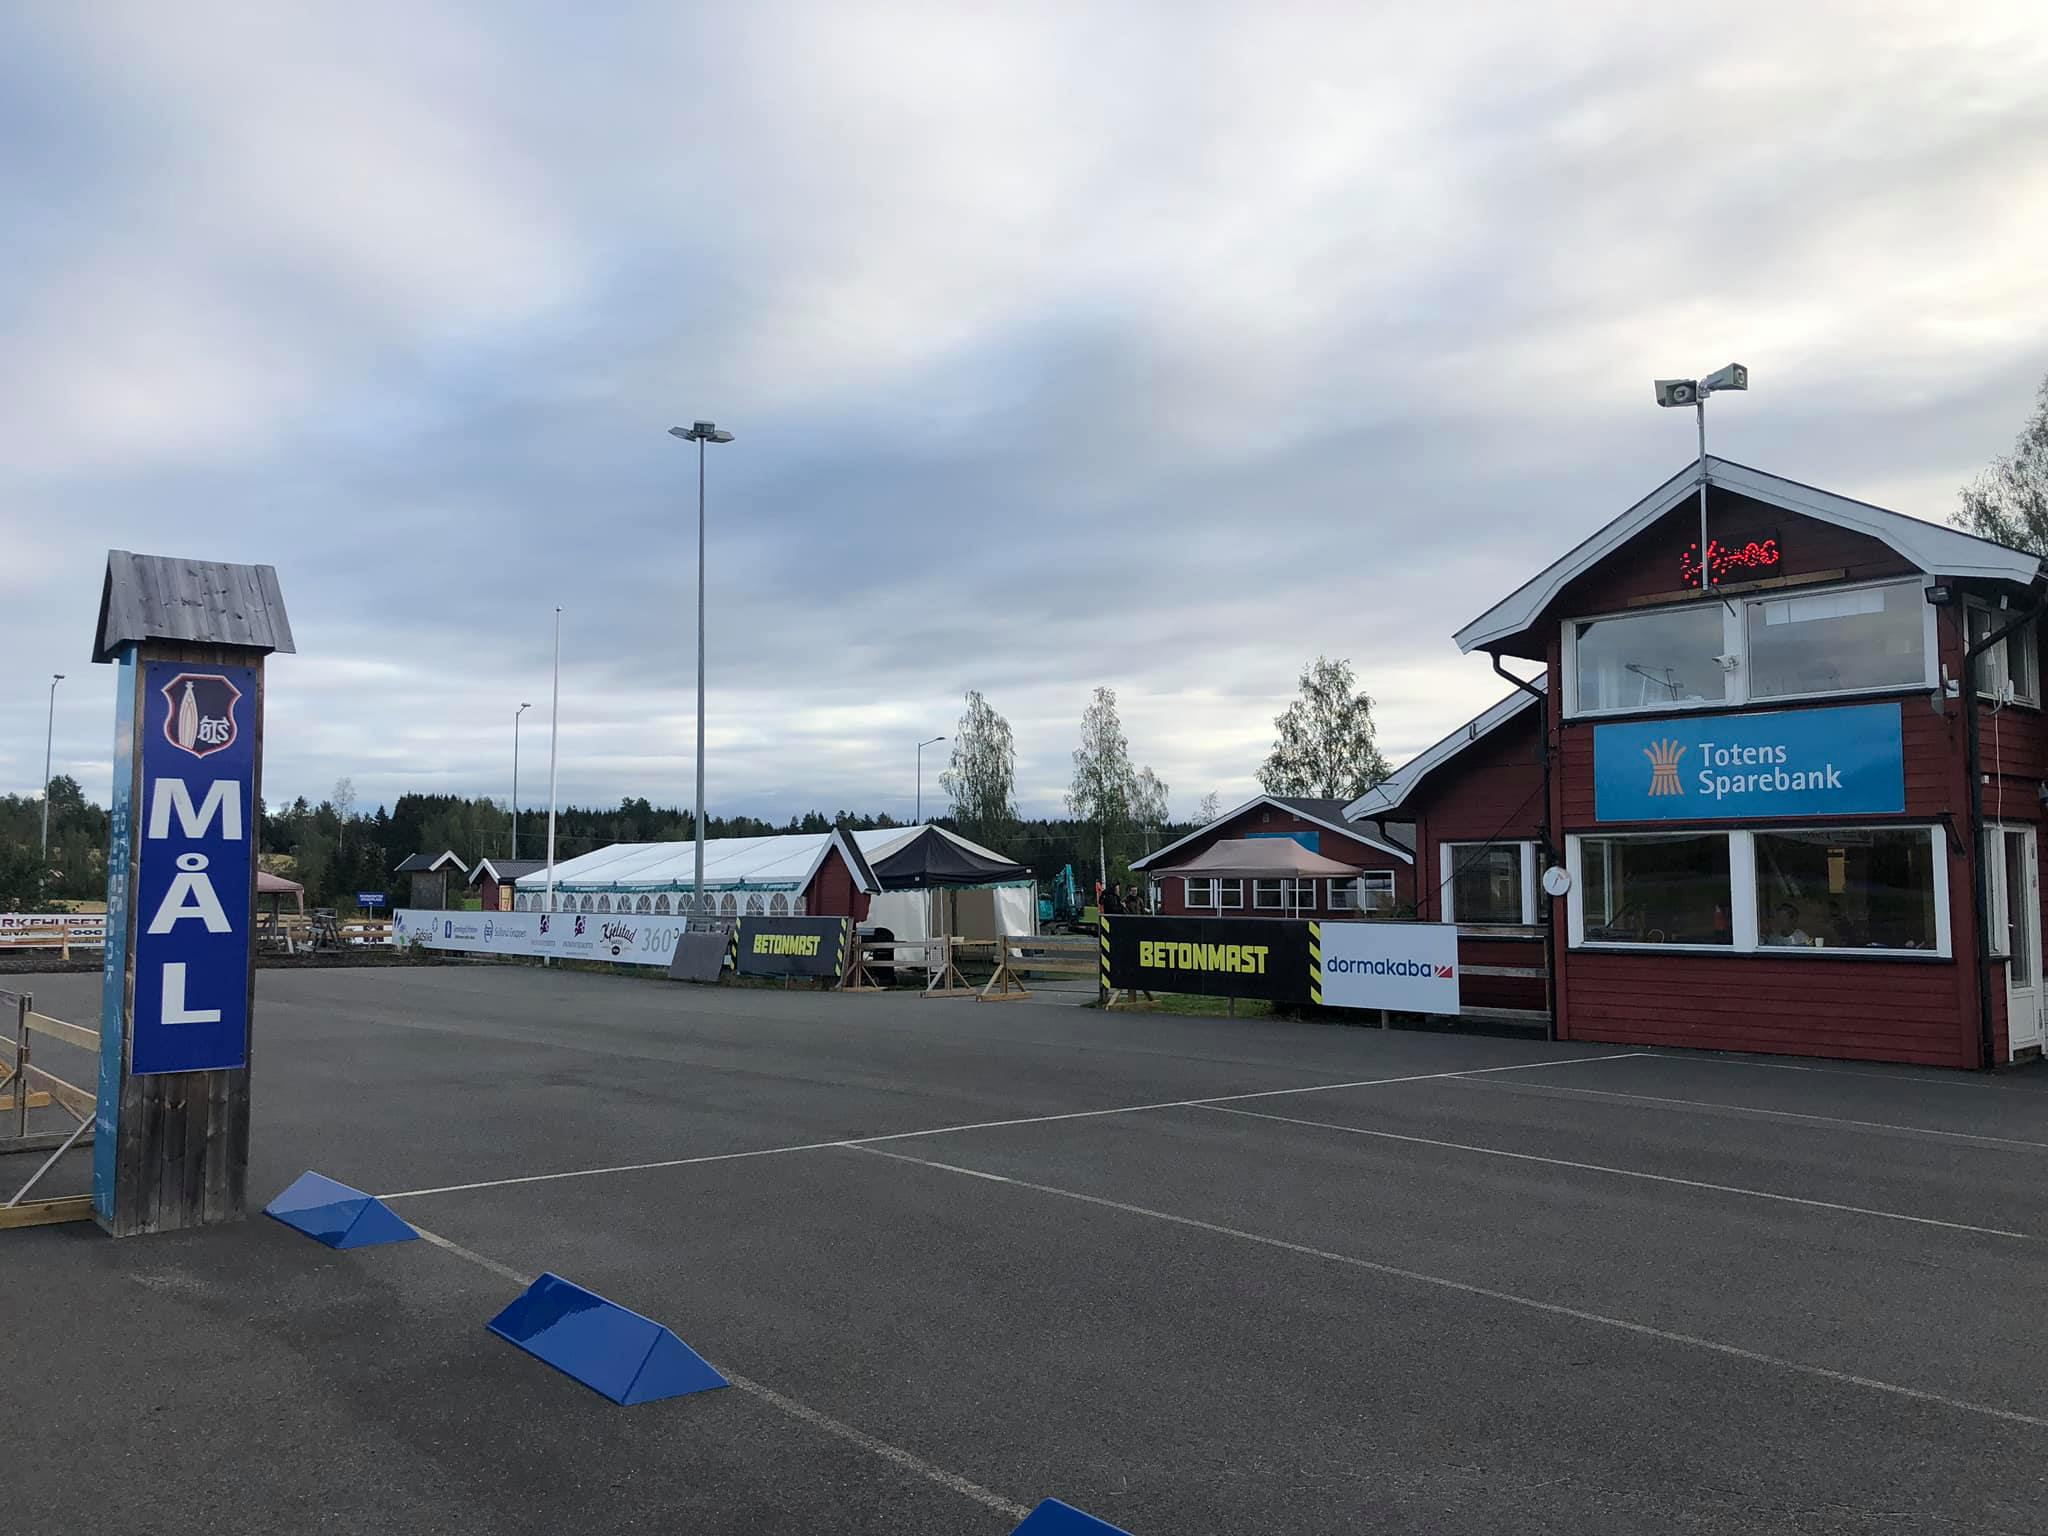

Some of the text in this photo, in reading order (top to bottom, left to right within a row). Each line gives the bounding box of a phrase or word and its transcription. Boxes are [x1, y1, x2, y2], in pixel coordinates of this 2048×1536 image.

[1699, 743, 1787, 767] Totens
[1699, 764, 1842, 800] Sparebank
[148, 778, 242, 1024] MÅL
[600, 920, 638, 944] Kjelstad
[752, 934, 821, 956] BETONMAST
[1139, 941, 1269, 974] BETONMAST
[1327, 956, 1432, 978] dormakaba
